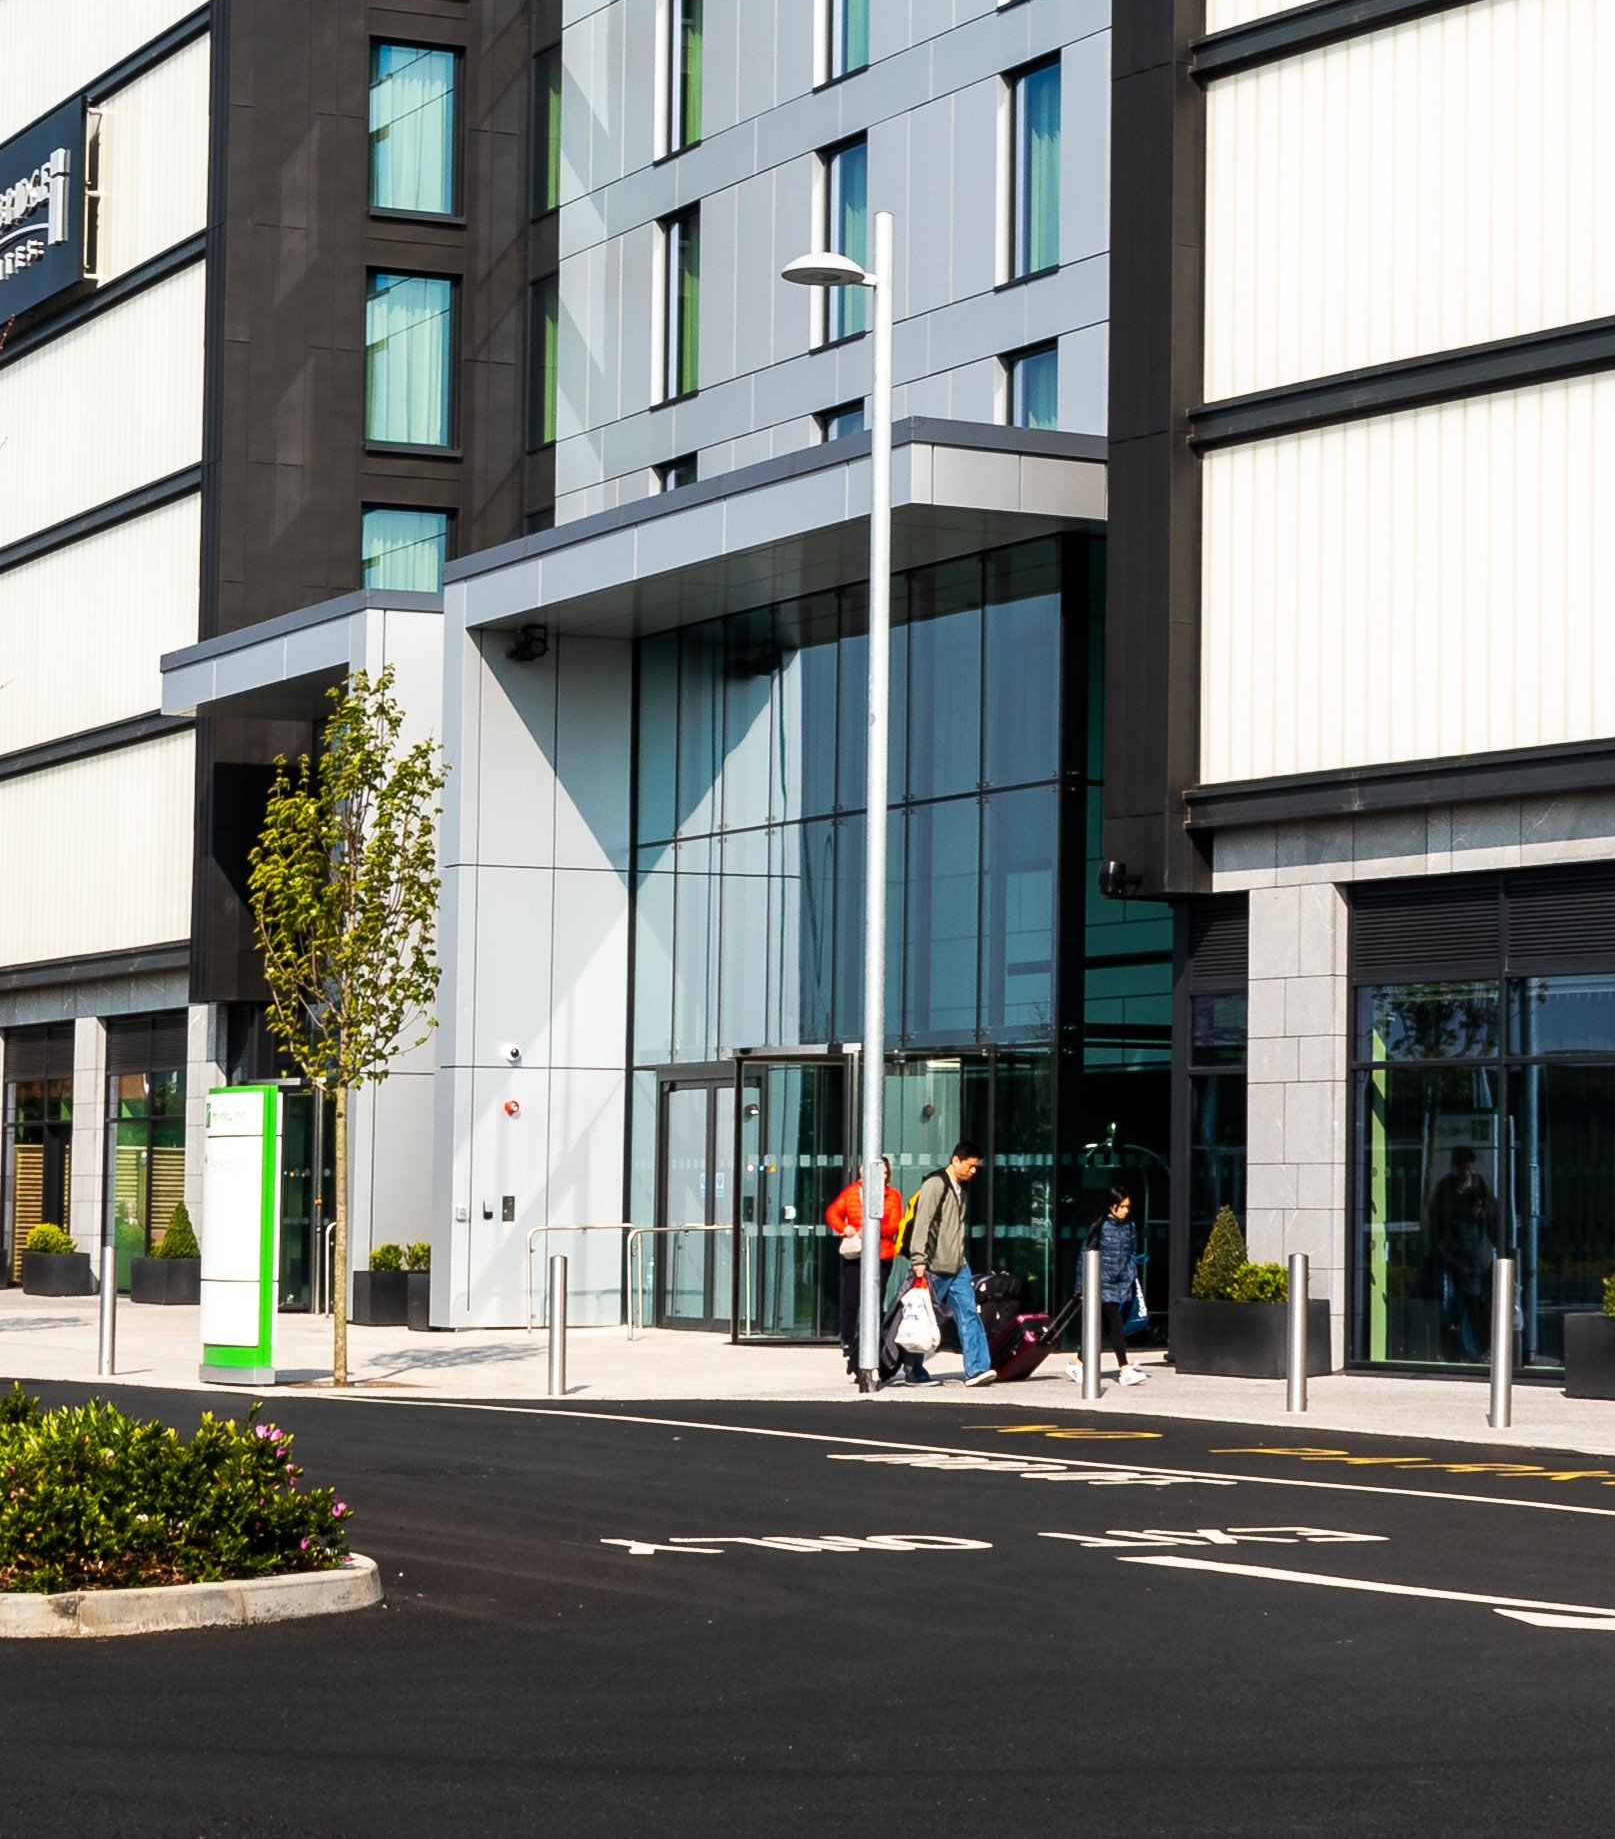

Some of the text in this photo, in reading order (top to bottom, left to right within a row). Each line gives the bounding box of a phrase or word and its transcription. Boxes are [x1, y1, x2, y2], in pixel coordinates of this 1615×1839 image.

[961, 1424, 1164, 1439] NO
[599, 1525, 1390, 1556] EXIT ONLY
